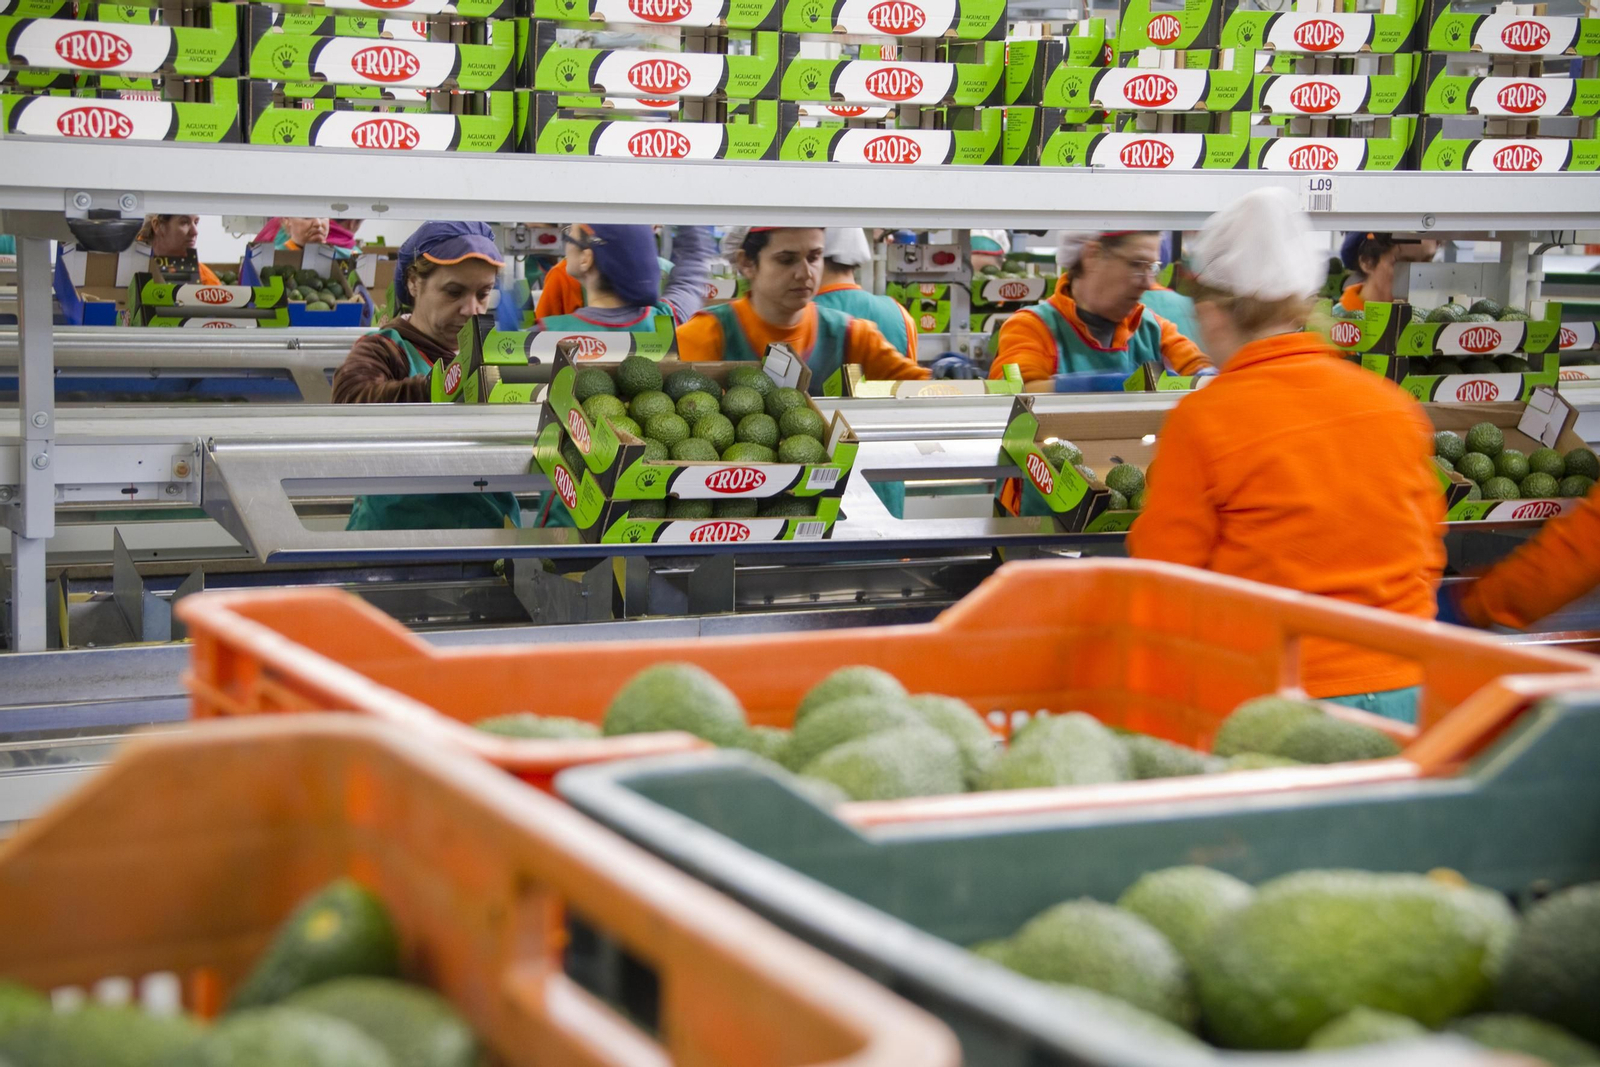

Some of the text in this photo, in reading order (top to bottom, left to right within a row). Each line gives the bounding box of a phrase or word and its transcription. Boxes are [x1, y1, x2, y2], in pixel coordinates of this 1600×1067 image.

[629, 0, 693, 17] TROPS
[868, 1, 924, 29] TROPS
[1147, 15, 1181, 45] TROPS
[1295, 20, 1343, 47] TROPS
[1503, 22, 1549, 47] TROPS
[58, 31, 129, 63] TROPS
[353, 47, 418, 77] TROPS
[630, 61, 689, 89] TROPS
[867, 69, 922, 96] TROPS
[1125, 76, 1176, 102] TROPS
[1291, 83, 1339, 108] TROPS
[1499, 84, 1545, 109] TROPS
[59, 108, 131, 139] TROPS
[353, 121, 418, 150] TROPS
[630, 129, 689, 158] TROPS
[865, 137, 920, 164] TROPS
[1121, 141, 1173, 169] TROPS
[1289, 146, 1337, 170] TROPS
[1495, 146, 1541, 171] TROPS
[1309, 178, 1332, 191] L09
[197, 286, 233, 303] TROPS
[1000, 282, 1029, 299] TROPS
[1330, 322, 1362, 345] TROPS
[1460, 328, 1500, 351] TROPS
[1457, 381, 1497, 402] TROPS
[568, 408, 592, 454] TROPS
[555, 465, 578, 509] TROPS
[706, 467, 765, 490] TROPS
[1026, 453, 1053, 495] TROPS
[1513, 502, 1560, 520] TROPS
[691, 522, 749, 542] TROPS
